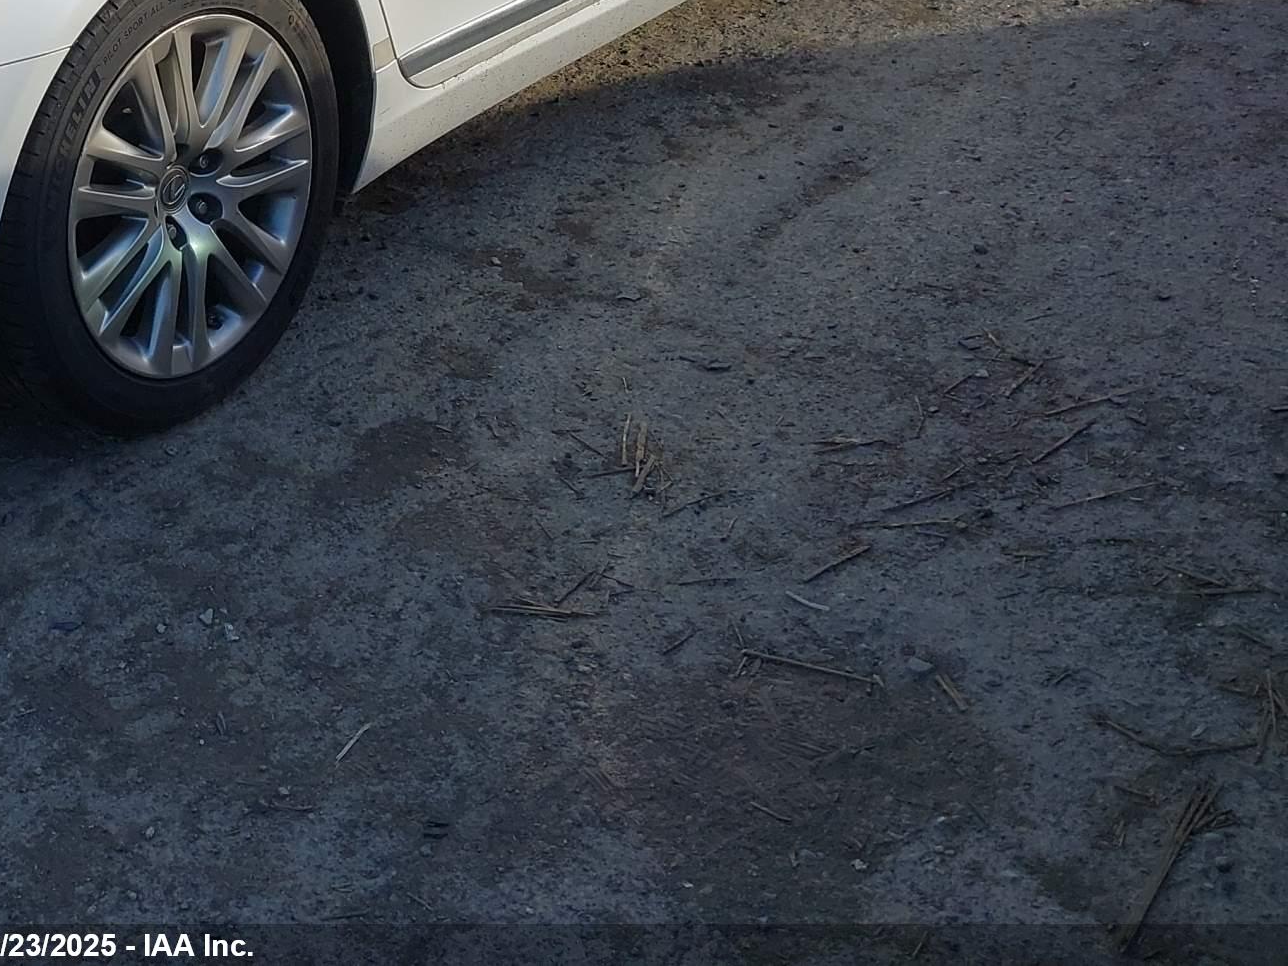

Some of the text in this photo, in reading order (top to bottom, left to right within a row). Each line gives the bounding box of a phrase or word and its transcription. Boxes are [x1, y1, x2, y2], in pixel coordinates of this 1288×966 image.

[102, 38, 122, 65] PILOT
[123, 11, 149, 39] SPORT
[150, 2, 166, 16] ALL
